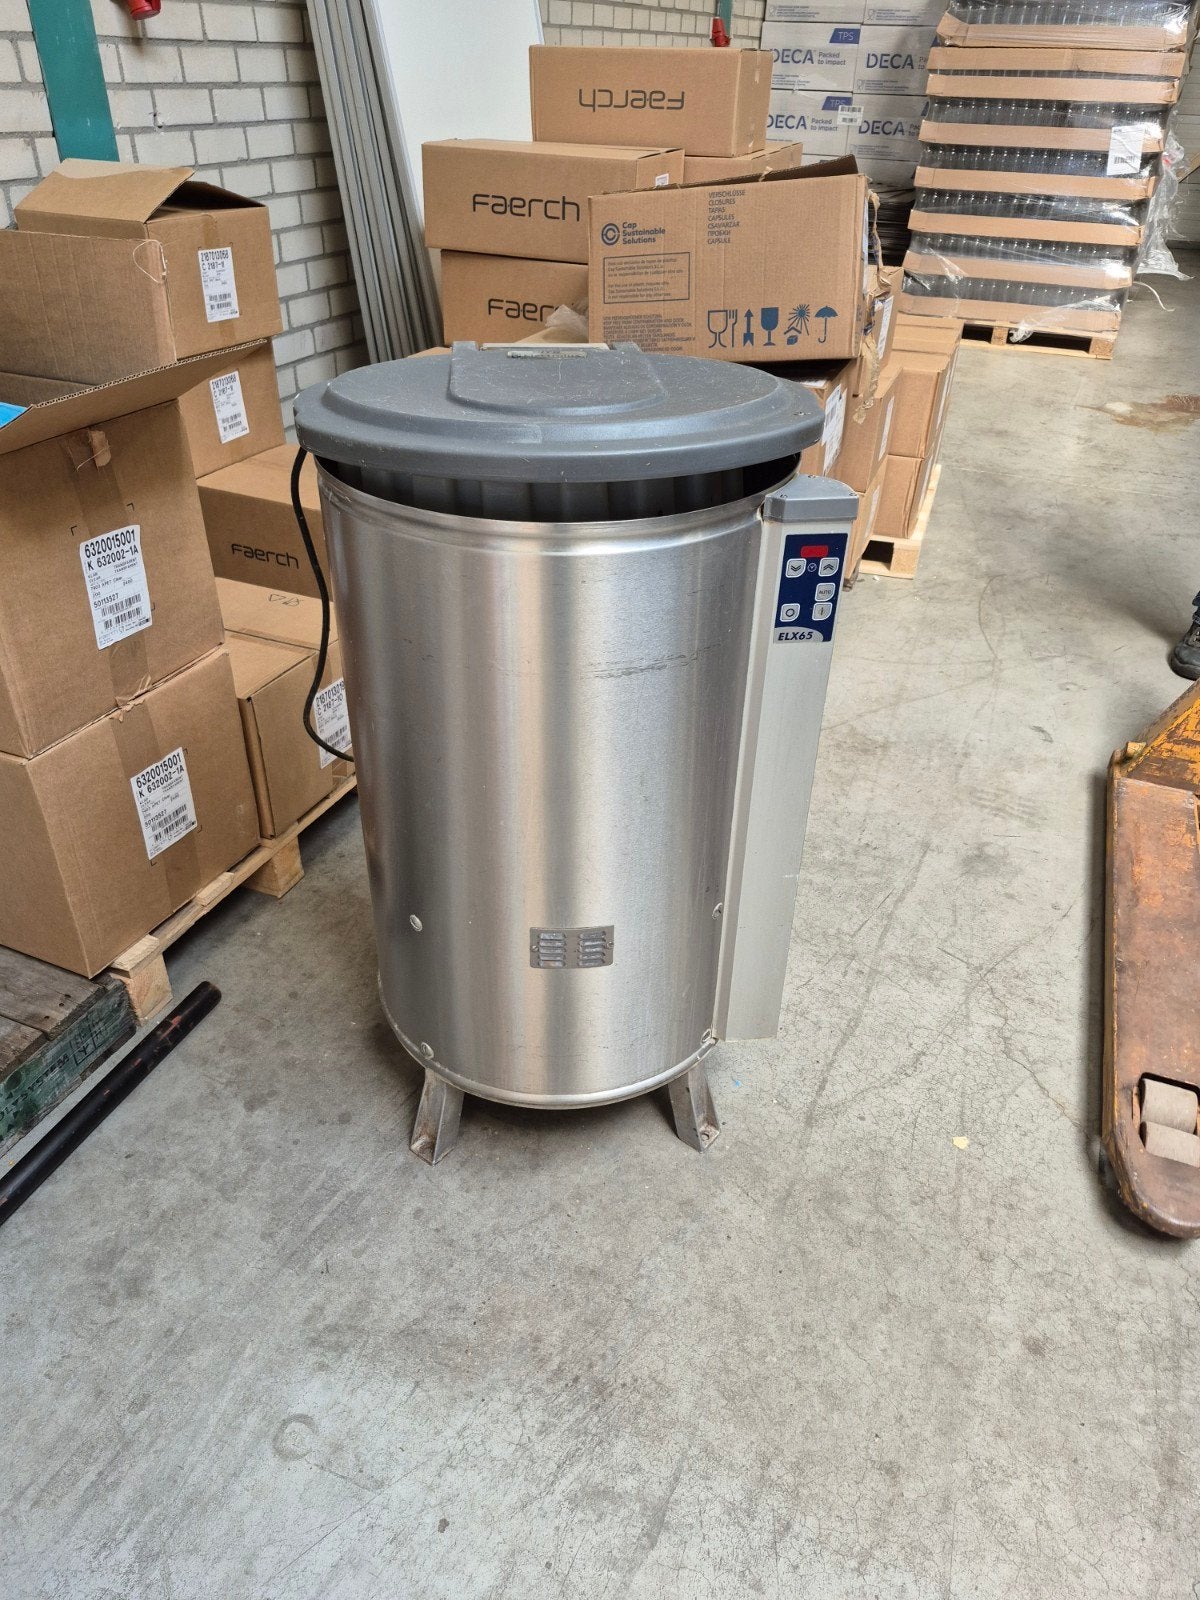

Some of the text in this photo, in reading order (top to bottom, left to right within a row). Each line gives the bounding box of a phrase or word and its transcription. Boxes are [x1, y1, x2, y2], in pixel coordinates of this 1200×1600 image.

[838, 31, 854, 41] TPS
[770, 48, 815, 65] DECA
[818, 51, 841, 59] Packed
[866, 53, 915, 69] DECA
[578, 88, 685, 112] Faerch
[811, 117, 833, 125] Packed
[858, 120, 905, 136] DECA
[472, 193, 581, 222] Faerch
[708, 198, 737, 207] CLOSURES
[622, 221, 637, 229] Cap
[707, 214, 735, 222] CAPSULES
[622, 228, 666, 237] Sustainable
[622, 236, 657, 245] Solutions
[488, 298, 560, 322] Faer
[84, 528, 136, 559] 6320015001
[87, 544, 139, 571] K 632002-1A
[231, 543, 300, 570] Faerch
[778, 631, 813, 642] ELX65
[135, 752, 182, 789] 6320015001
[138, 789, 145, 799] K
[147, 764, 185, 794] 632002-1A
